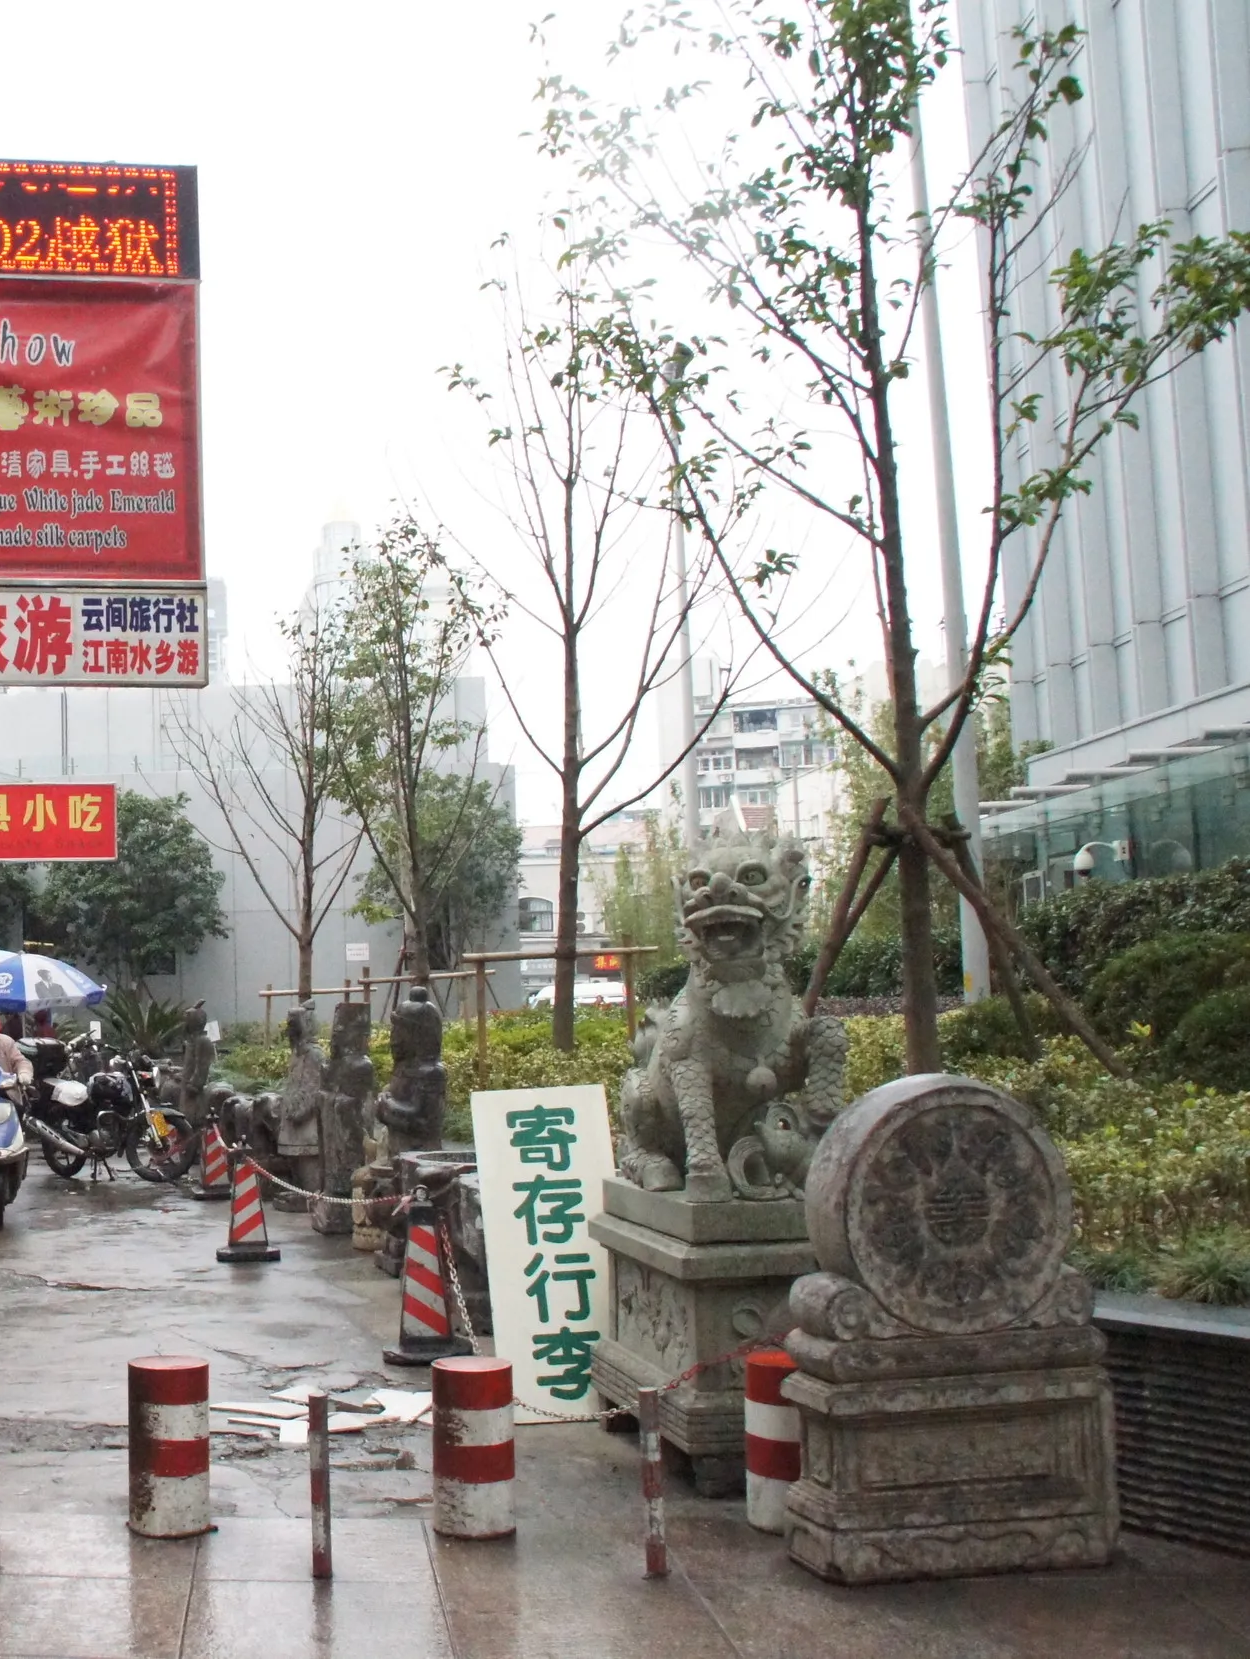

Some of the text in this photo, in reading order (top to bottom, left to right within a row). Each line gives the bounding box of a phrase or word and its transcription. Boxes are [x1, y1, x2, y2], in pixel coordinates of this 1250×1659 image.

[23, 486, 68, 513] White
[71, 488, 104, 518] jade
[109, 488, 175, 513] Emerald
[35, 523, 65, 547] silk
[68, 525, 127, 554] carpets
[81, 597, 199, 633] 云间旅行社
[82, 639, 199, 675] 江南水乡游
[506, 1104, 601, 1400] 寄存行李
